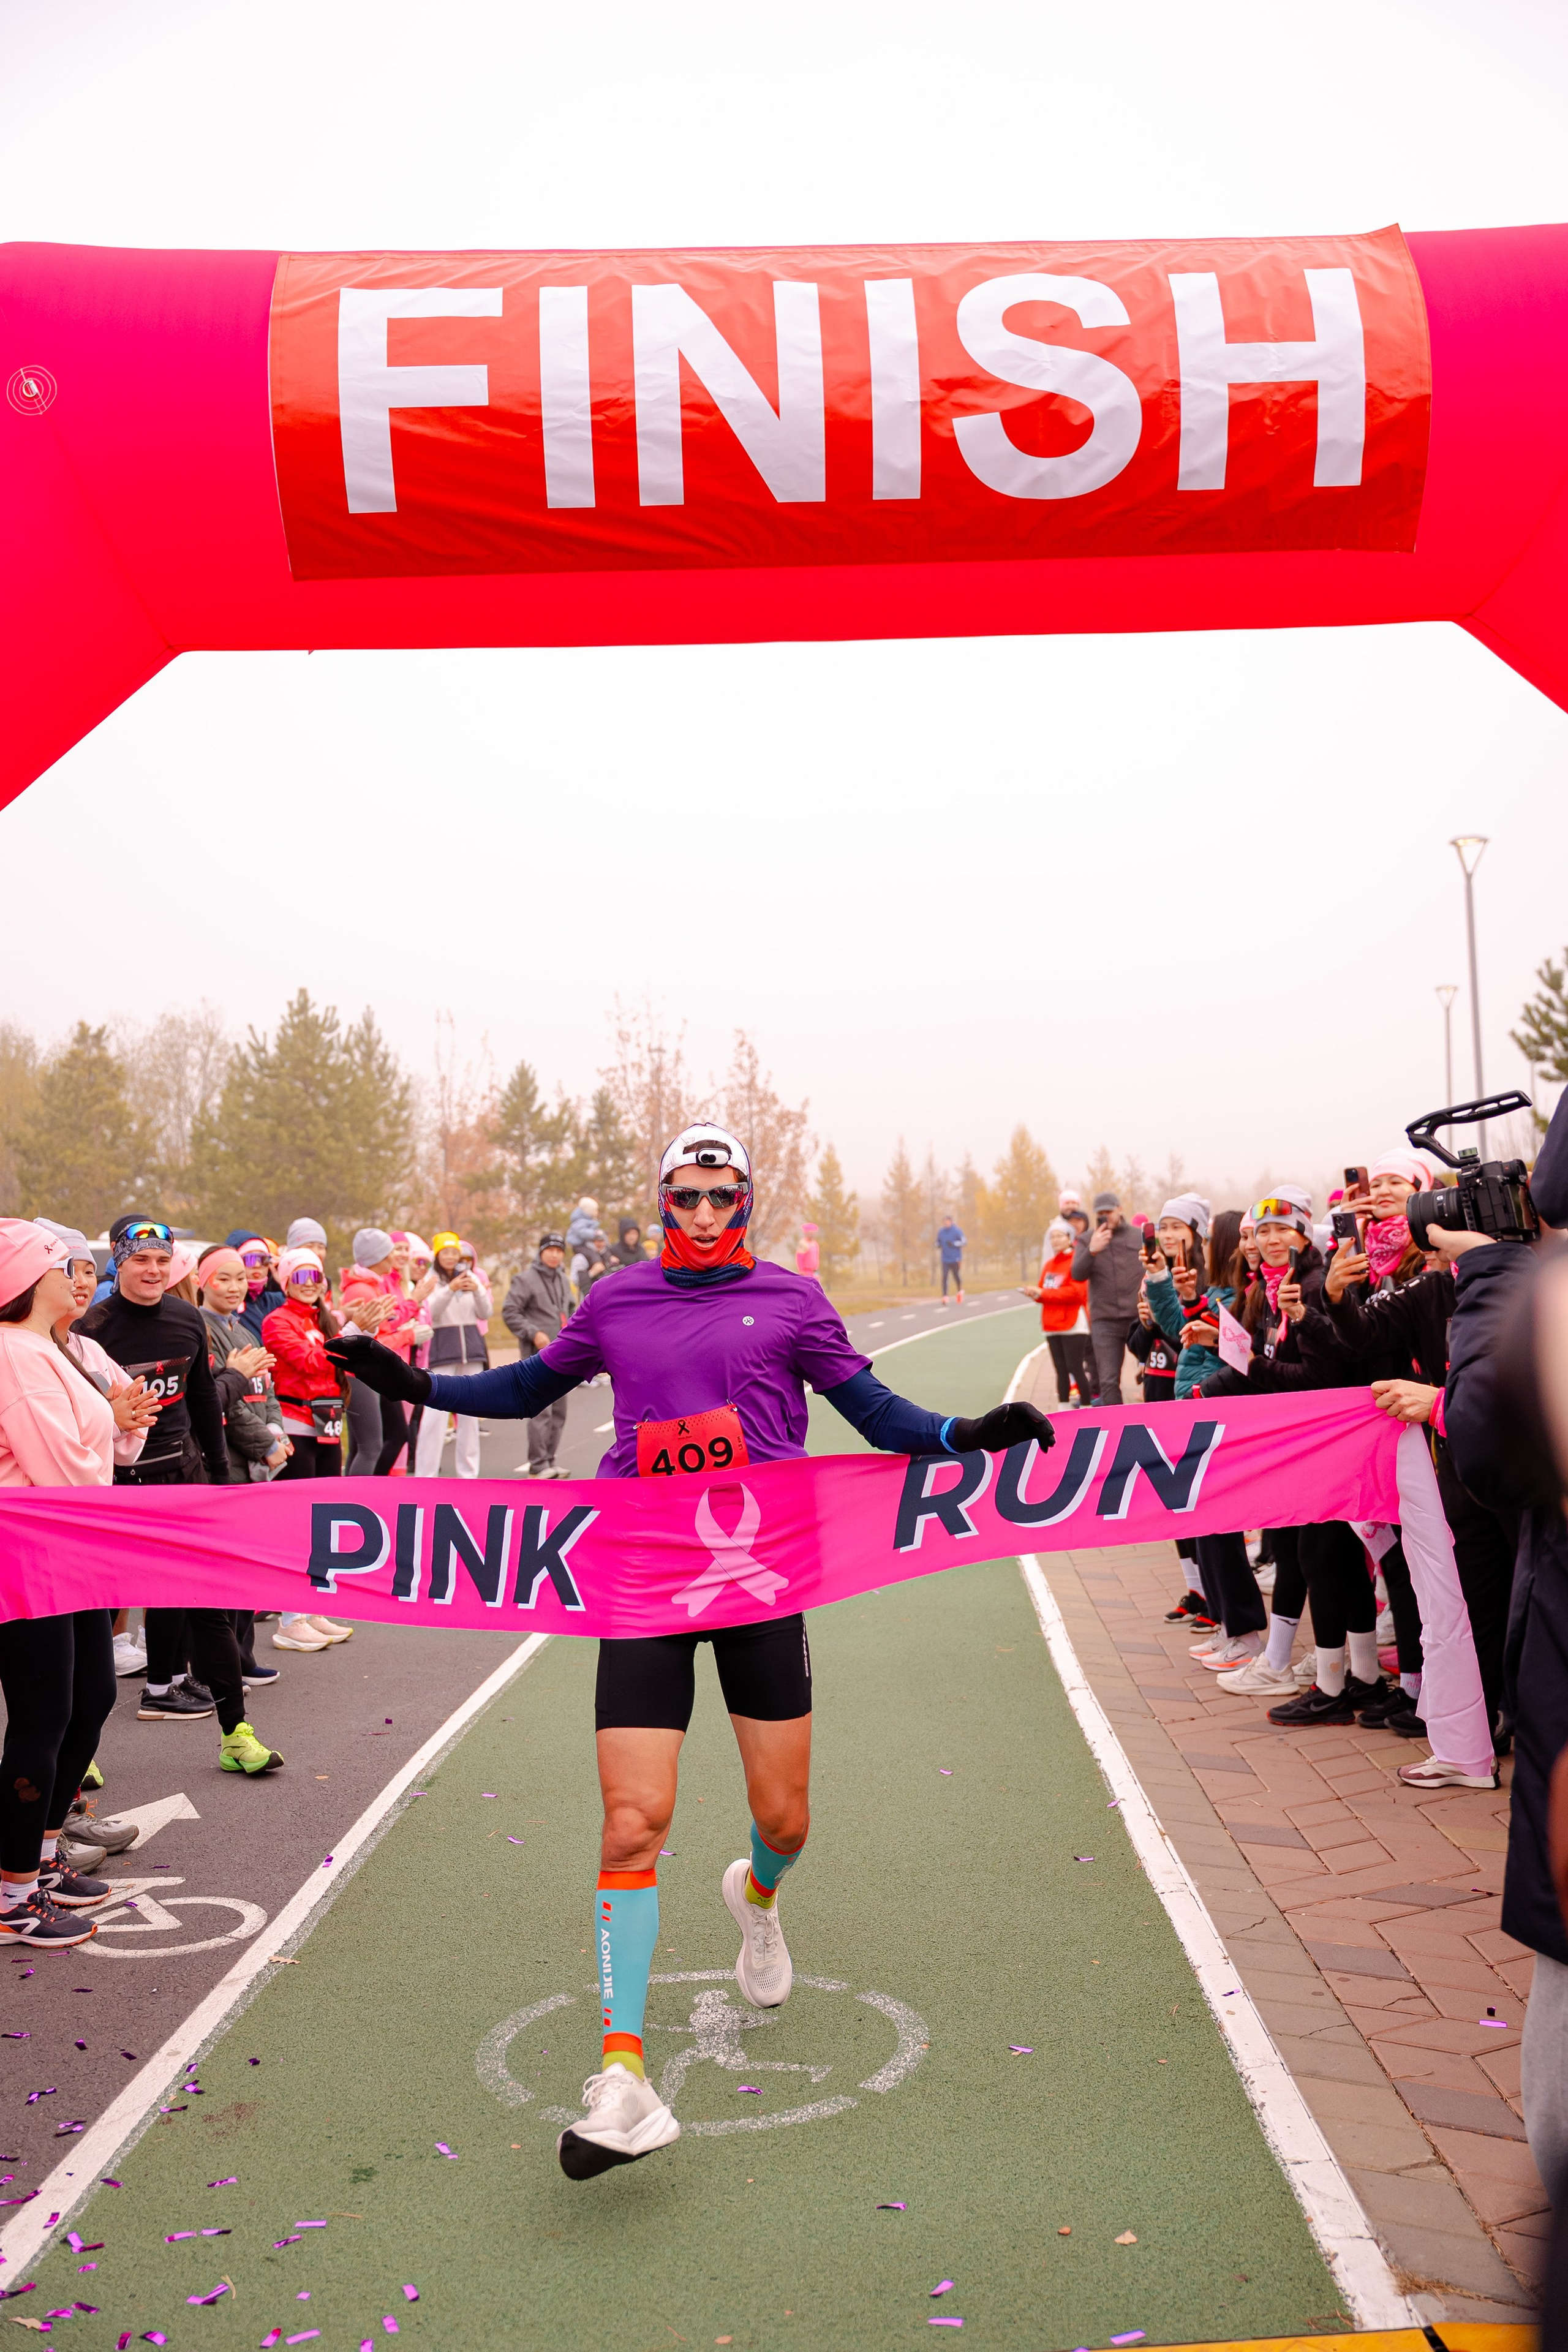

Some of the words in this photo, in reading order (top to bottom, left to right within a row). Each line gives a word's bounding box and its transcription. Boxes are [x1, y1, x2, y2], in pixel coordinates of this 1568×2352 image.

[338, 267, 1365, 514] FINISH
[252, 1377, 263, 1394] 15
[1150, 1351, 1167, 1369] 59
[650, 1436, 734, 1476] 409
[306, 1502, 601, 1611] PINK
[893, 1420, 1226, 1553] RUN
[601, 1928, 614, 1999] AONIJIE
